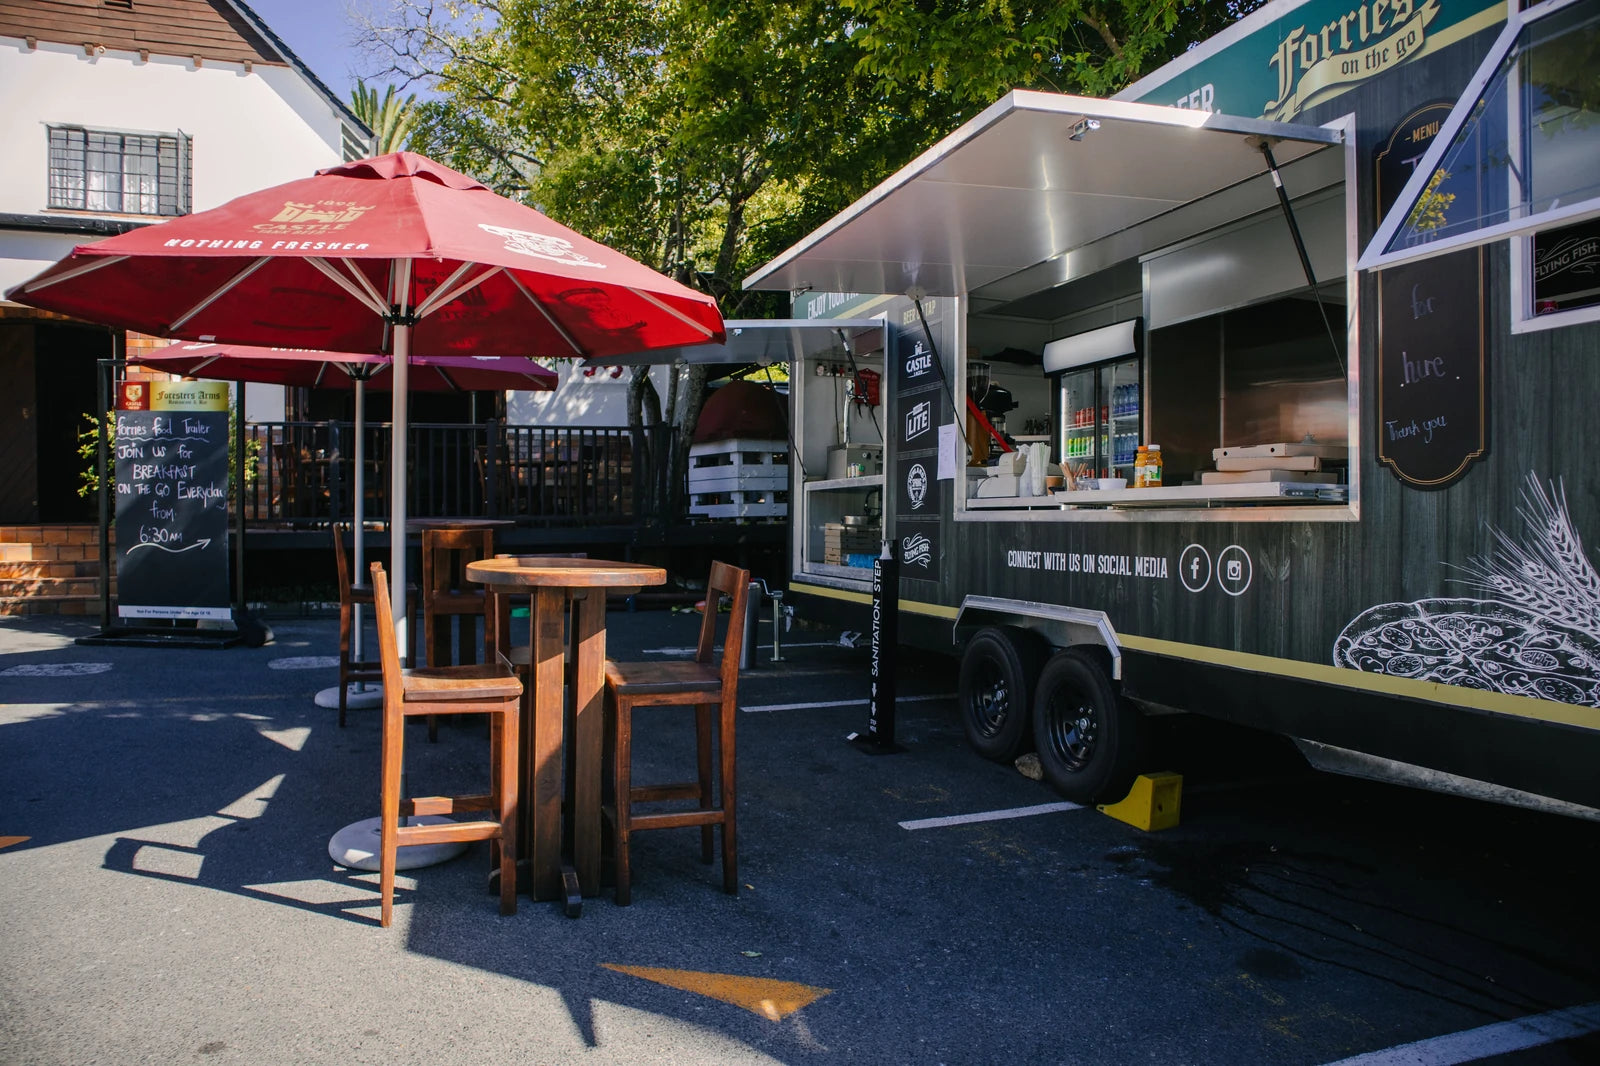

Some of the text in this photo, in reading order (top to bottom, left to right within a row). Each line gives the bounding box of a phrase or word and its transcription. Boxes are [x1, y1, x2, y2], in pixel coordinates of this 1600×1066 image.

[1341, 30, 1416, 75] on the go
[1412, 120, 1440, 143] MENU
[164, 238, 369, 250] NOTHING FRESHER
[1535, 242, 1599, 277] FLYING FISH
[808, 293, 826, 320] ENJOY
[925, 300, 936, 317] TAP
[906, 355, 931, 373] CASTLE
[156, 390, 221, 400] Foresters Arms
[909, 410, 928, 436] LITE
[1386, 415, 1447, 443] Thank you
[117, 483, 131, 494] ON
[134, 483, 151, 495] THE
[155, 483, 171, 497] GO
[1007, 550, 1168, 578] CONNECT WITH US ON SOCIAL MEDIA
[871, 560, 881, 677] SANITATION STEP
